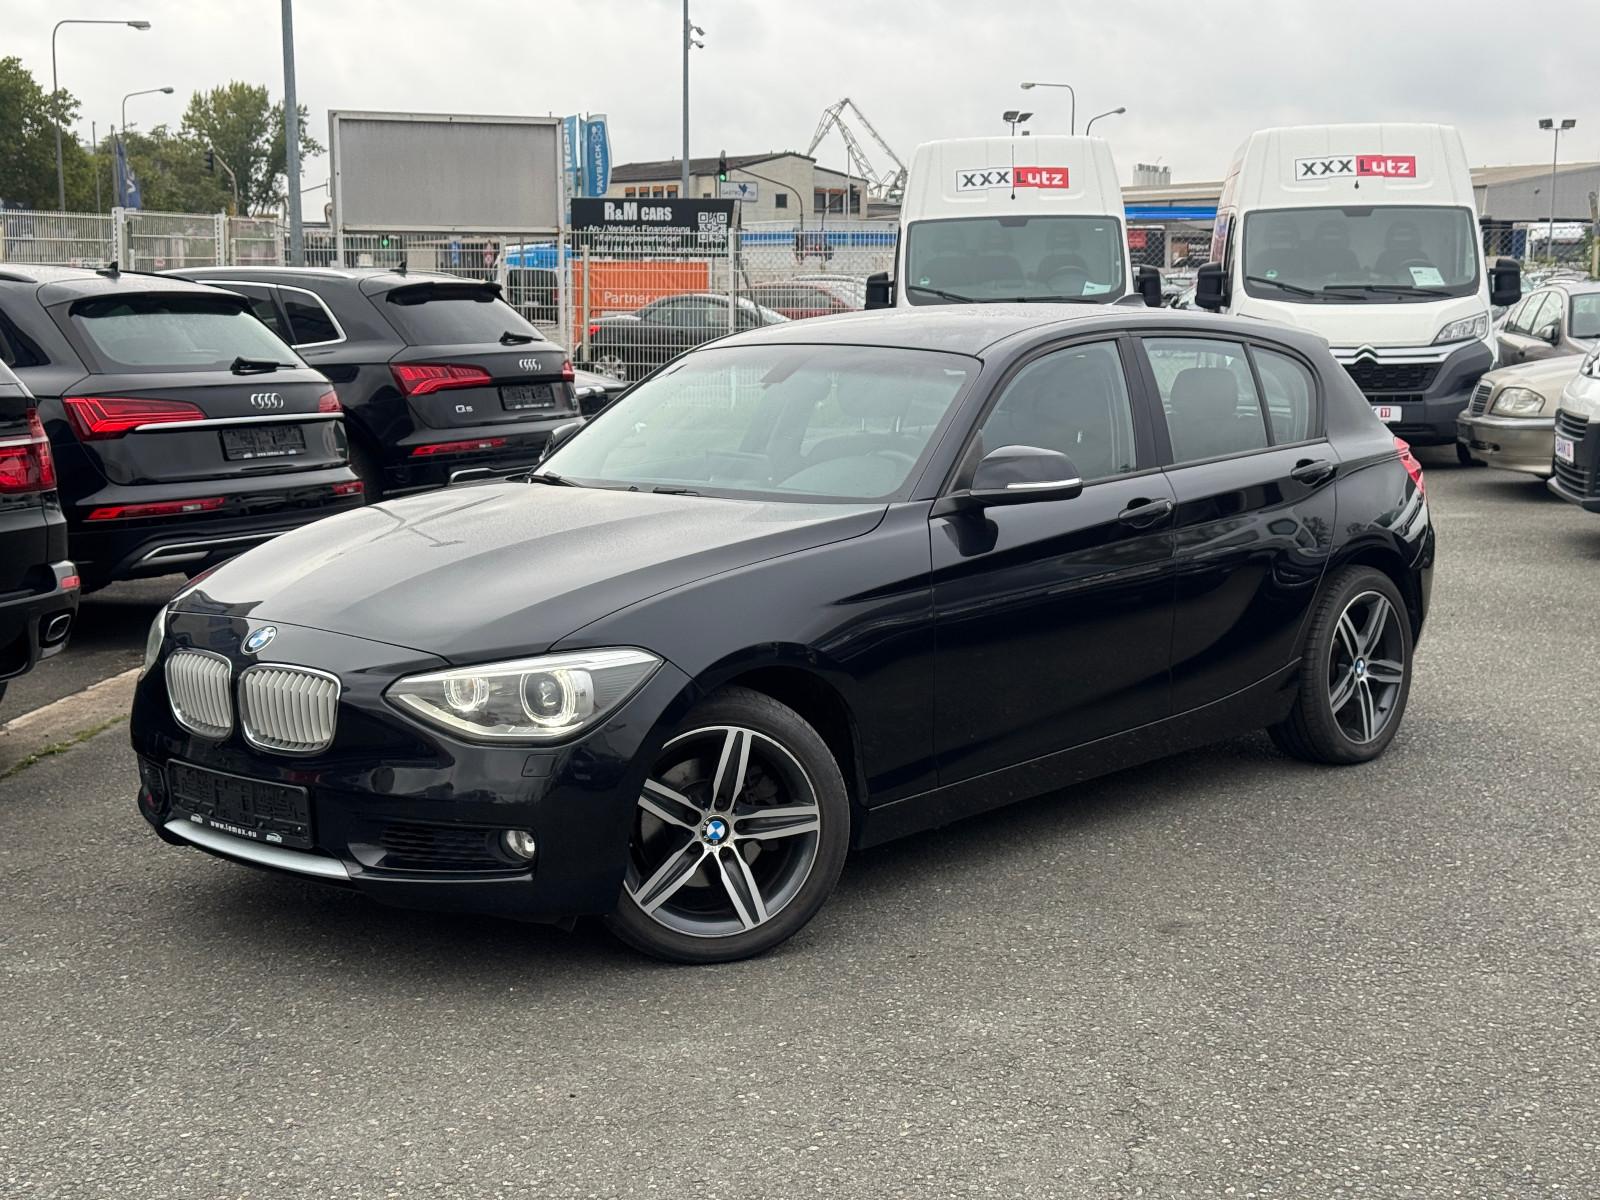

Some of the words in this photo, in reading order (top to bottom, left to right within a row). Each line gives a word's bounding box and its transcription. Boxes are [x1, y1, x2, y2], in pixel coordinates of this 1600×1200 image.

[594, 143, 604, 194] PAYBACK
[604, 202, 638, 220] R&M
[641, 207, 672, 221] CARS
[608, 225, 636, 233] Verkauf
[642, 225, 690, 235] Finanzierung
[604, 291, 652, 304] Partner
[455, 405, 473, 413] Q5
[210, 820, 257, 838] www.lemax.eu
